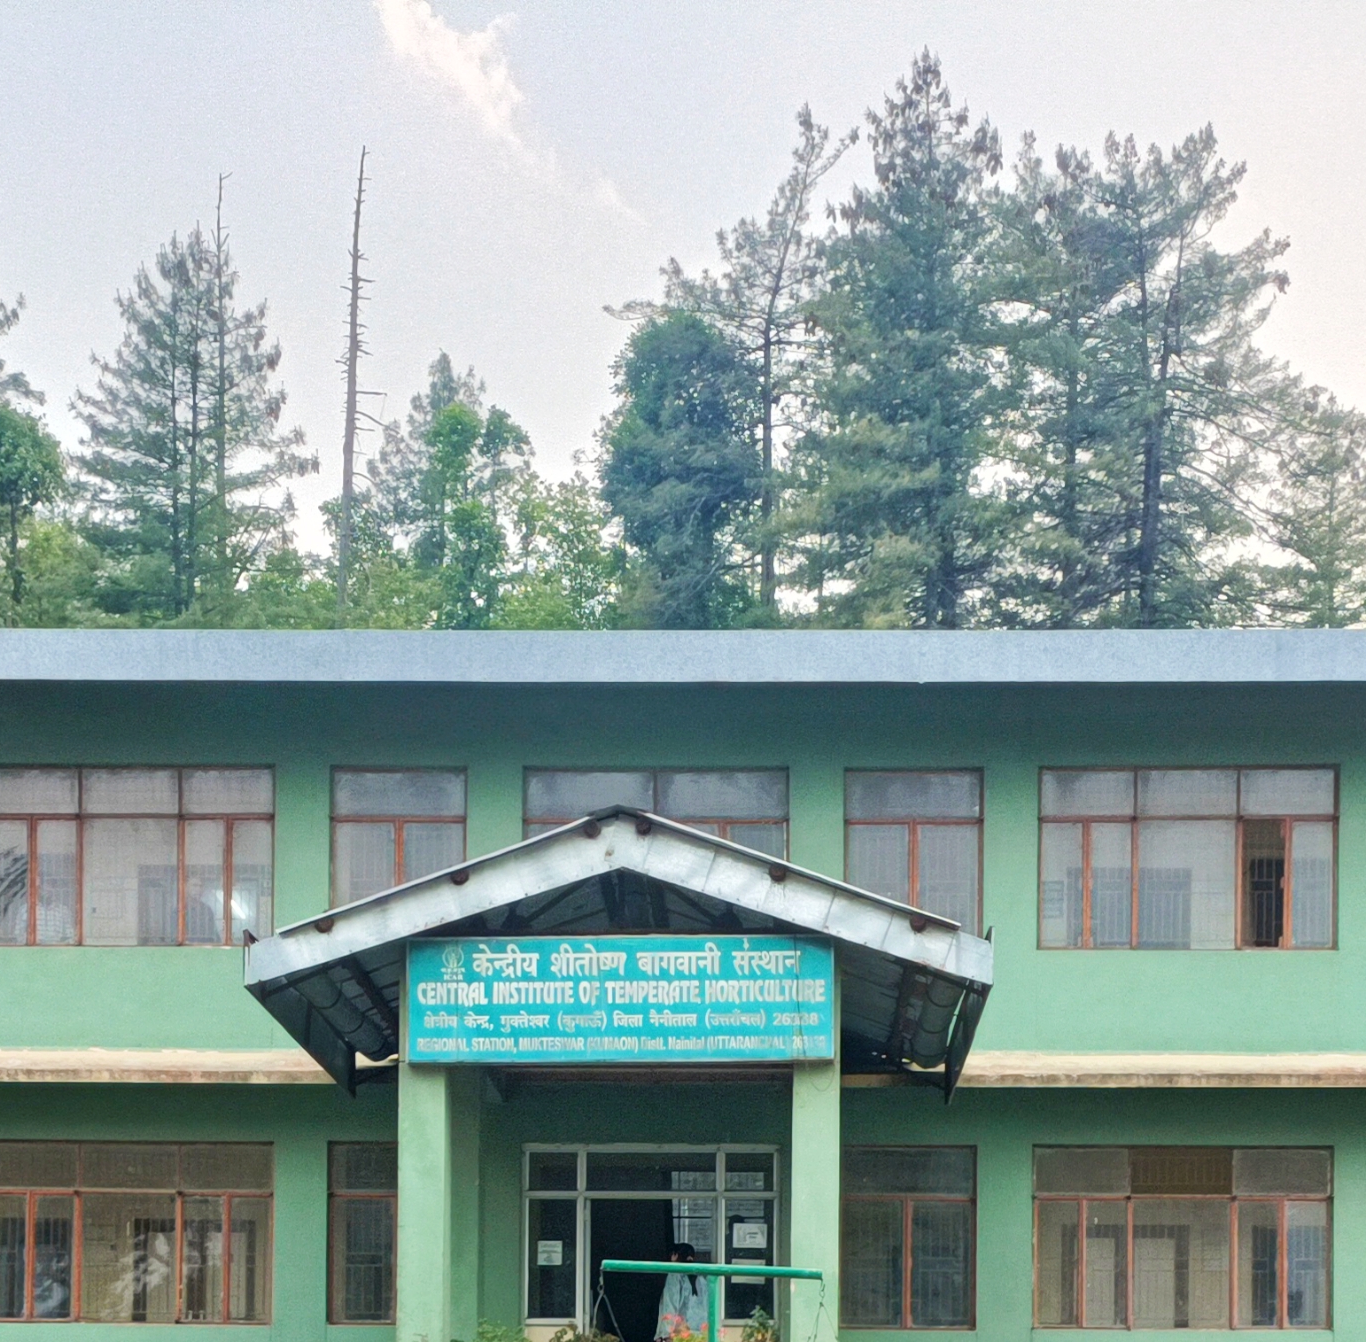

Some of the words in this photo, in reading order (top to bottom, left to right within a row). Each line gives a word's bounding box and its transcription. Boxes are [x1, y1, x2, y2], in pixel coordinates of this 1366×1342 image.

[472, 943, 540, 978] केन्द्रीय
[550, 943, 627, 978] शीतोष्ण
[637, 942, 721, 976] बागवानी
[731, 938, 801, 976] संस्थान
[443, 973, 464, 981] ICAR
[417, 981, 489, 1007] CENTRAL
[492, 981, 575, 1006] INSTITUTE
[578, 981, 601, 1006] OF
[604, 980, 701, 1006] TEMPERATE
[705, 979, 826, 1005] HORTICULTURE
[613, 1010, 643, 1027] जिला
[649, 1009, 697, 1027] नैनीताल
[417, 1037, 469, 1051] REGIONAL
[471, 1036, 517, 1054] STATION,
[519, 1036, 585, 1051] MUKTESWAR
[668, 1035, 705, 1050] Nainital
